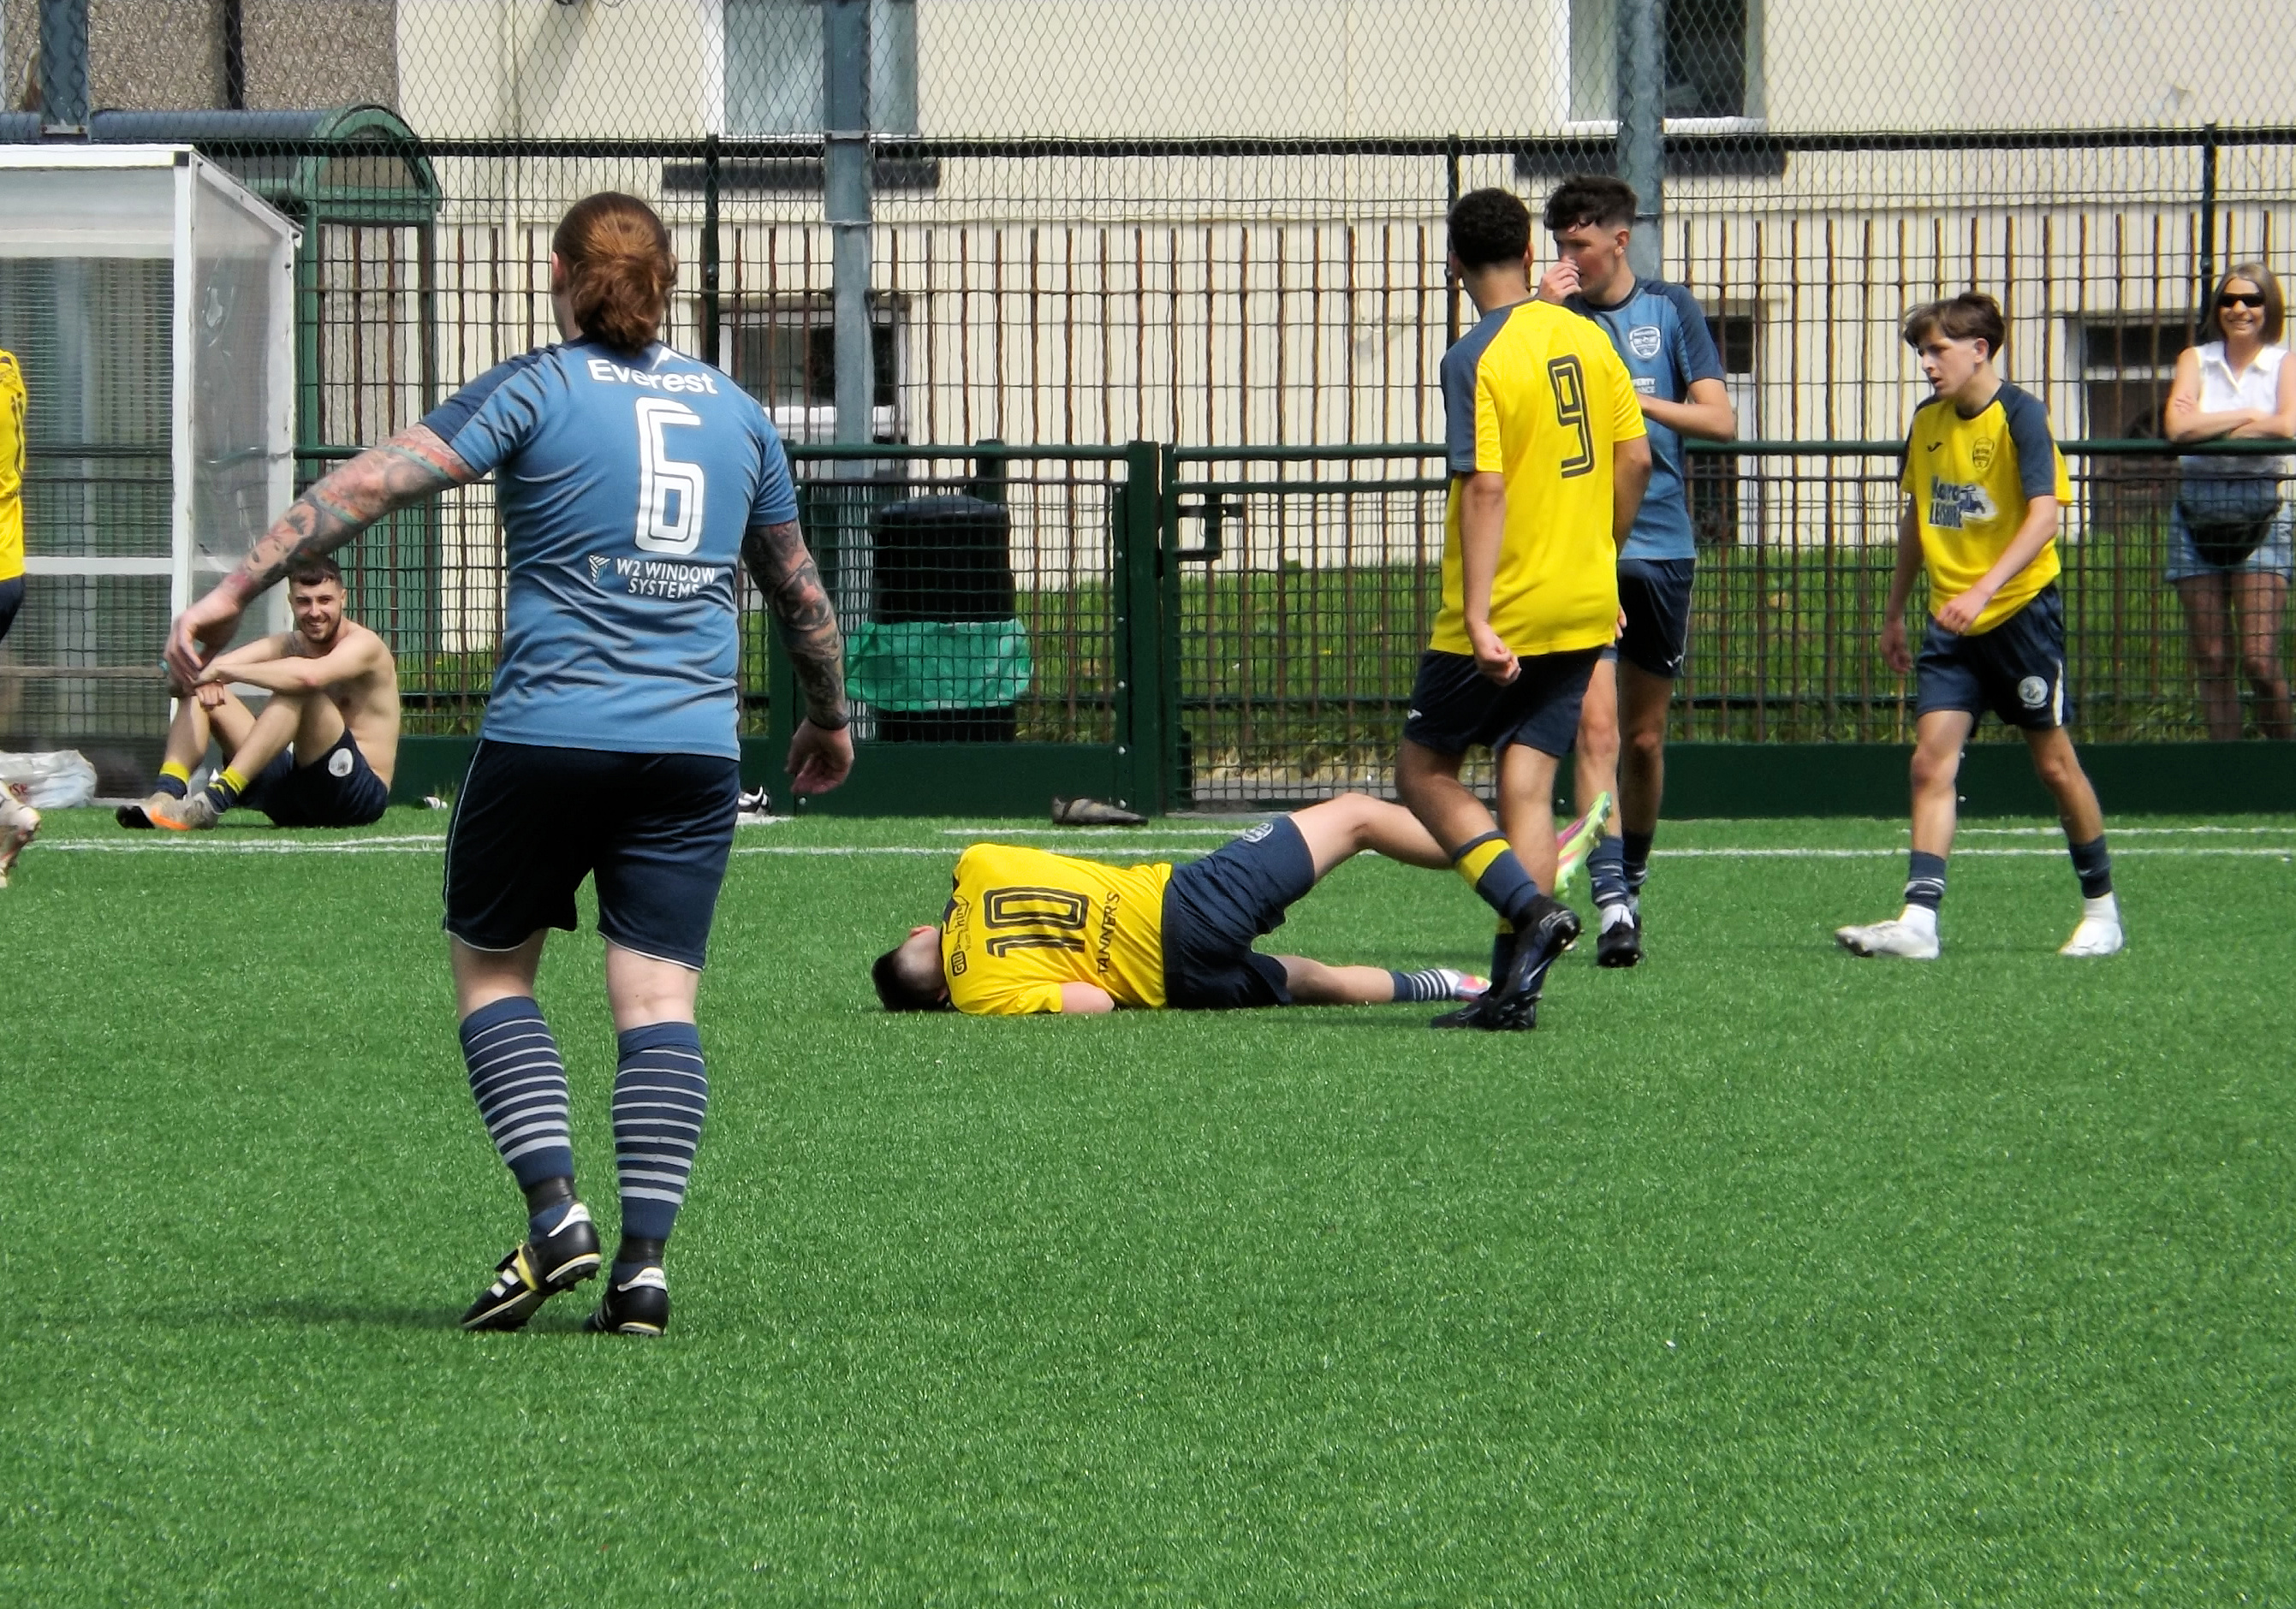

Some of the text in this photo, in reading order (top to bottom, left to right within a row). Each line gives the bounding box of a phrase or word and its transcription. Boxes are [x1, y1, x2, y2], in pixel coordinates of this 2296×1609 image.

[586, 359, 718, 395] Everest
[1548, 353, 1595, 479] 9
[635, 397, 705, 555] 6
[616, 558, 716, 585] W2 WINDOW
[628, 578, 700, 598] SYSTEMS
[984, 887, 1090, 958] 10
[1096, 891, 1120, 974] TANNER'S
